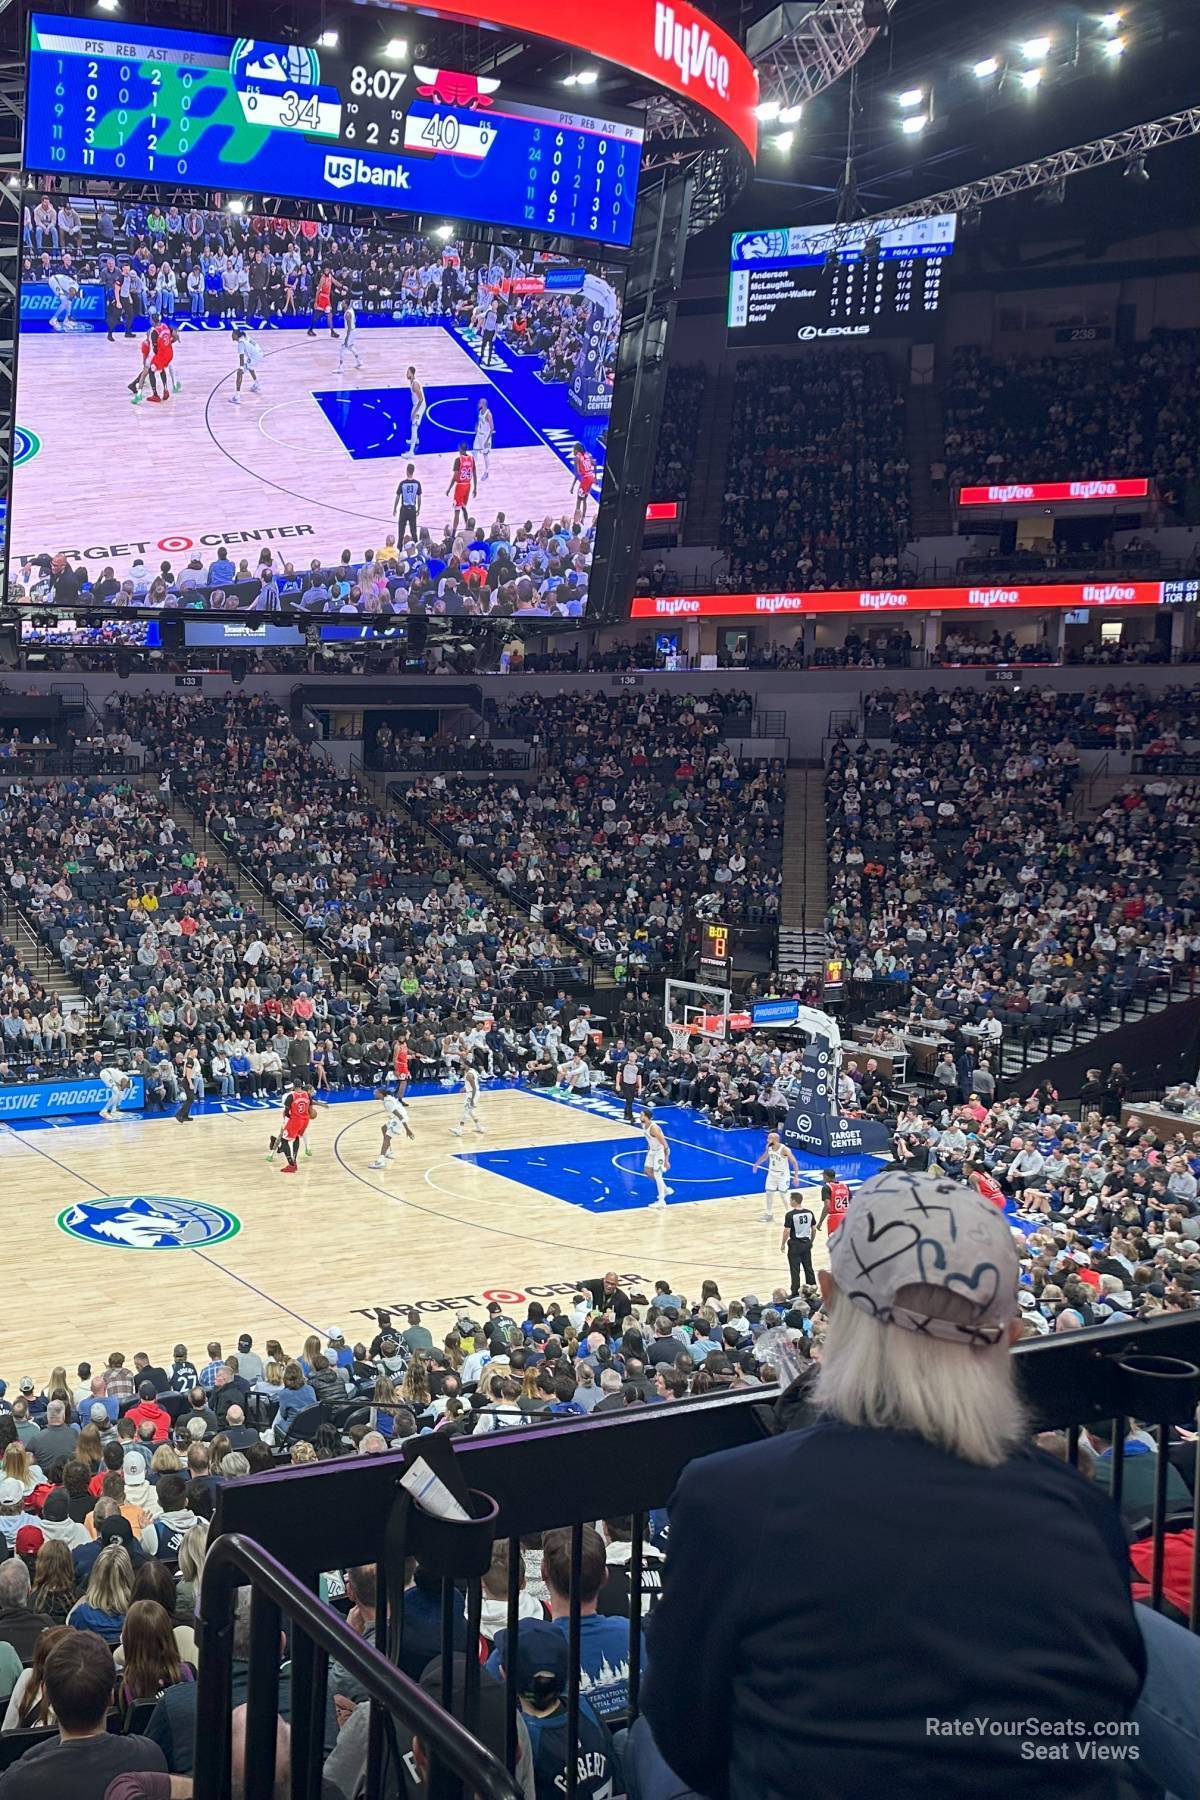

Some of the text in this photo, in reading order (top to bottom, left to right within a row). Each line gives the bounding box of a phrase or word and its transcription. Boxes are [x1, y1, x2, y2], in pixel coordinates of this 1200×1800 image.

[85, 41, 195, 63] PTS REB AST PF
[655, 1, 729, 98] HyVee
[88, 63, 192, 88] 2 0 2 0
[351, 67, 406, 100] 8:07
[86, 85, 191, 110] 0 0 1 0
[86, 106, 189, 131] 2 0 1 0
[248, 91, 320, 129] 0 34
[347, 104, 358, 114] TO
[391, 110, 402, 120] TO
[346, 124, 399, 145] 6 2 5
[422, 113, 488, 149] 40 0
[560, 114, 633, 136] PTS REB AST PF
[85, 128, 188, 153] 3 1 2 0
[556, 132, 625, 158] 6 3 0 1
[83, 150, 187, 174] 11 0 1 0
[554, 152, 624, 177] 0 1 0 0
[552, 171, 622, 196] 0 2 1 0
[550, 190, 620, 215] 6 1 3 0
[547, 209, 616, 233] 5 1 3 1
[751, 270, 788, 279] Anderson
[927, 258, 942, 266] 0/0
[750, 289, 816, 300] Alexander-Walker
[898, 282, 911, 290] 1/4
[751, 280, 794, 289] McLaughlin
[749, 302, 776, 311] Conley
[749, 314, 766, 322] Reid
[817, 325, 870, 336] LEXUS
[988, 482, 1116, 502] HyVee HyVee
[200, 525, 315, 547] CENTER
[1165, 592, 1198, 604] TOR 81
[1166, 581, 1199, 594] PHI 93
[656, 586, 1135, 615] HyVee HyVee HyVee HyVee HyVee
[181, 677, 196, 686] 133
[709, 926, 728, 939] 8:07
[715, 938, 726, 957] 8
[298, 1102, 305, 1113] 3
[785, 1129, 822, 1146] CFMOTO
[830, 1130, 860, 1140] TARGET
[831, 1137, 862, 1148] CENTER
[835, 1196, 848, 1208] 24
[350, 1296, 482, 1323] TARGET
[177, 1375, 197, 1393] 27
